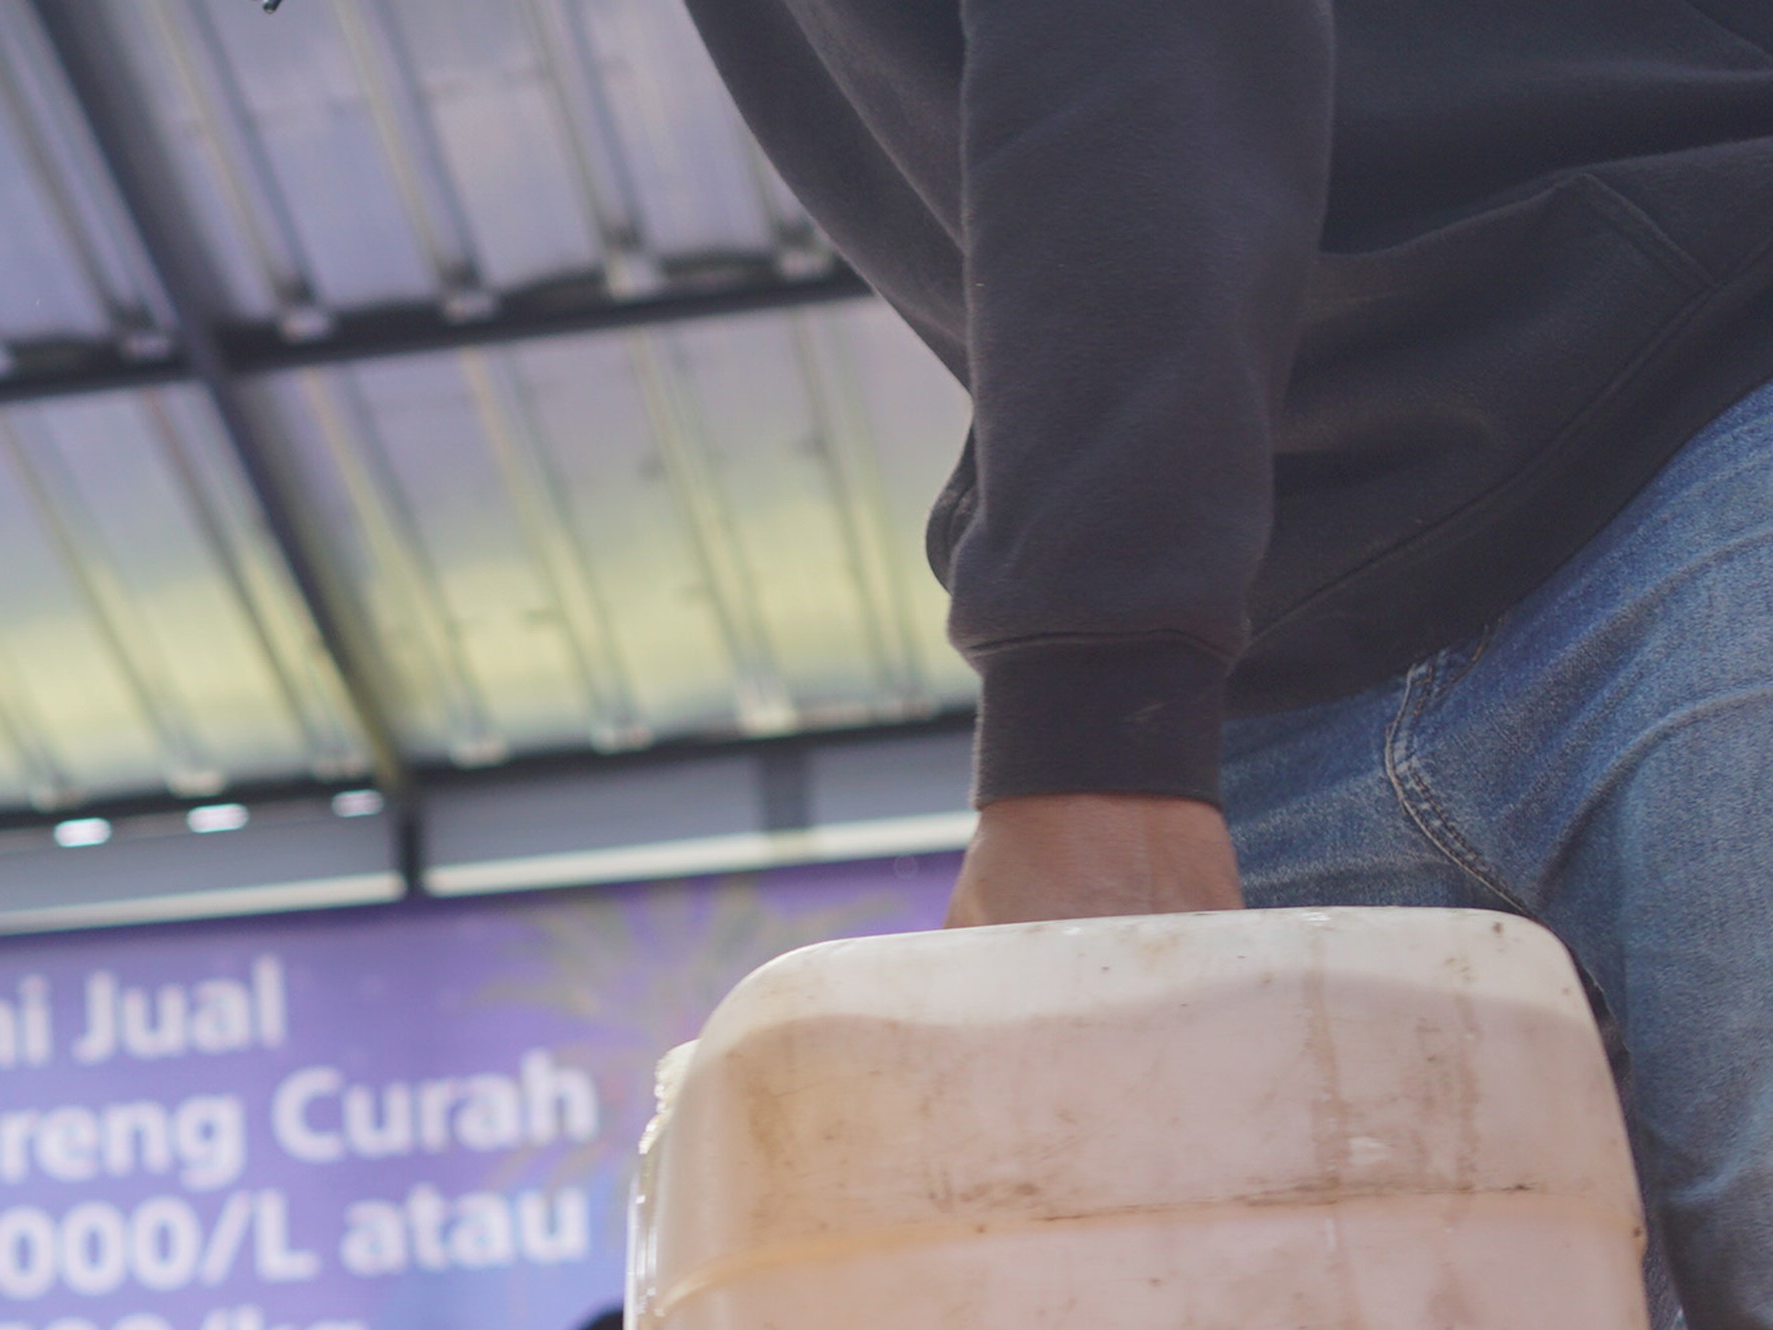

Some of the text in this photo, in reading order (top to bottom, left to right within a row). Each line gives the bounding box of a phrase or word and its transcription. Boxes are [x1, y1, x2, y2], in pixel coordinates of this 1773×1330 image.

[73, 953, 287, 1063] Jual
[271, 1047, 598, 1163] Curah
[341, 1182, 589, 1277] atau
